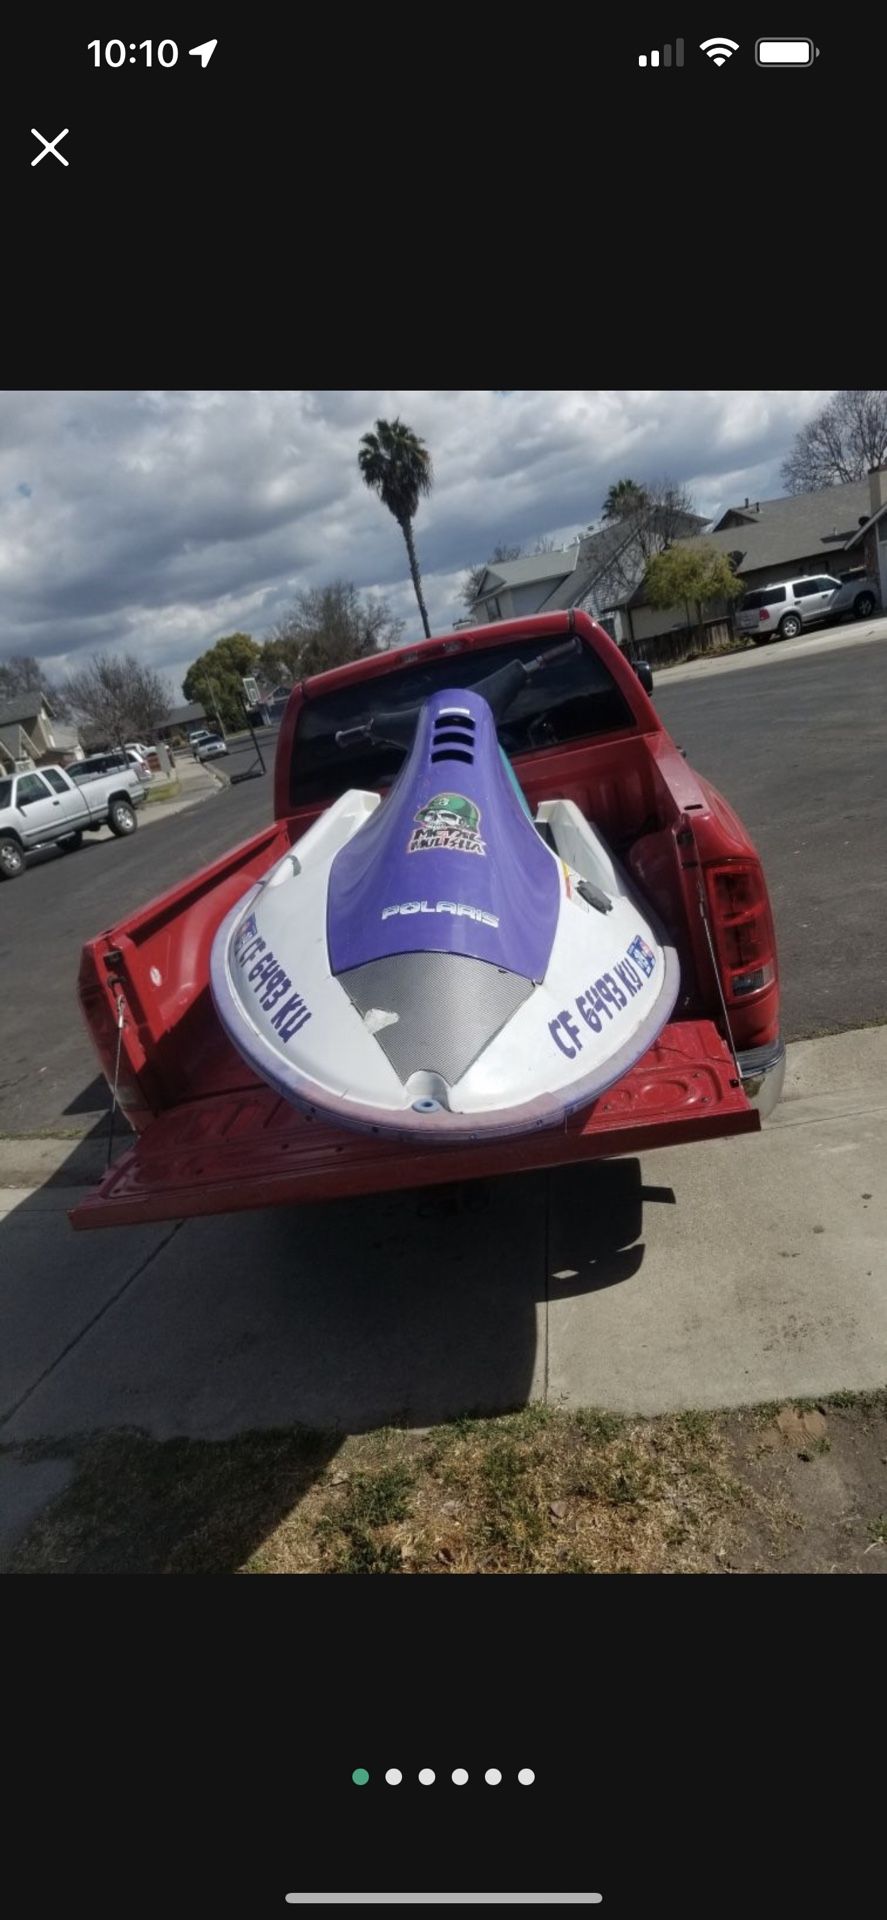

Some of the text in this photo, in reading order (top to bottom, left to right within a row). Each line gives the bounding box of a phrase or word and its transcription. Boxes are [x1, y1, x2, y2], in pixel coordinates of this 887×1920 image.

[381, 900, 500, 928] POLARIS
[238, 936, 267, 968] CF
[247, 951, 292, 1012] 6493
[270, 992, 312, 1044] KU
[547, 1010, 583, 1060] CF
[575, 972, 628, 1033] 6493
[612, 956, 644, 998] KU
